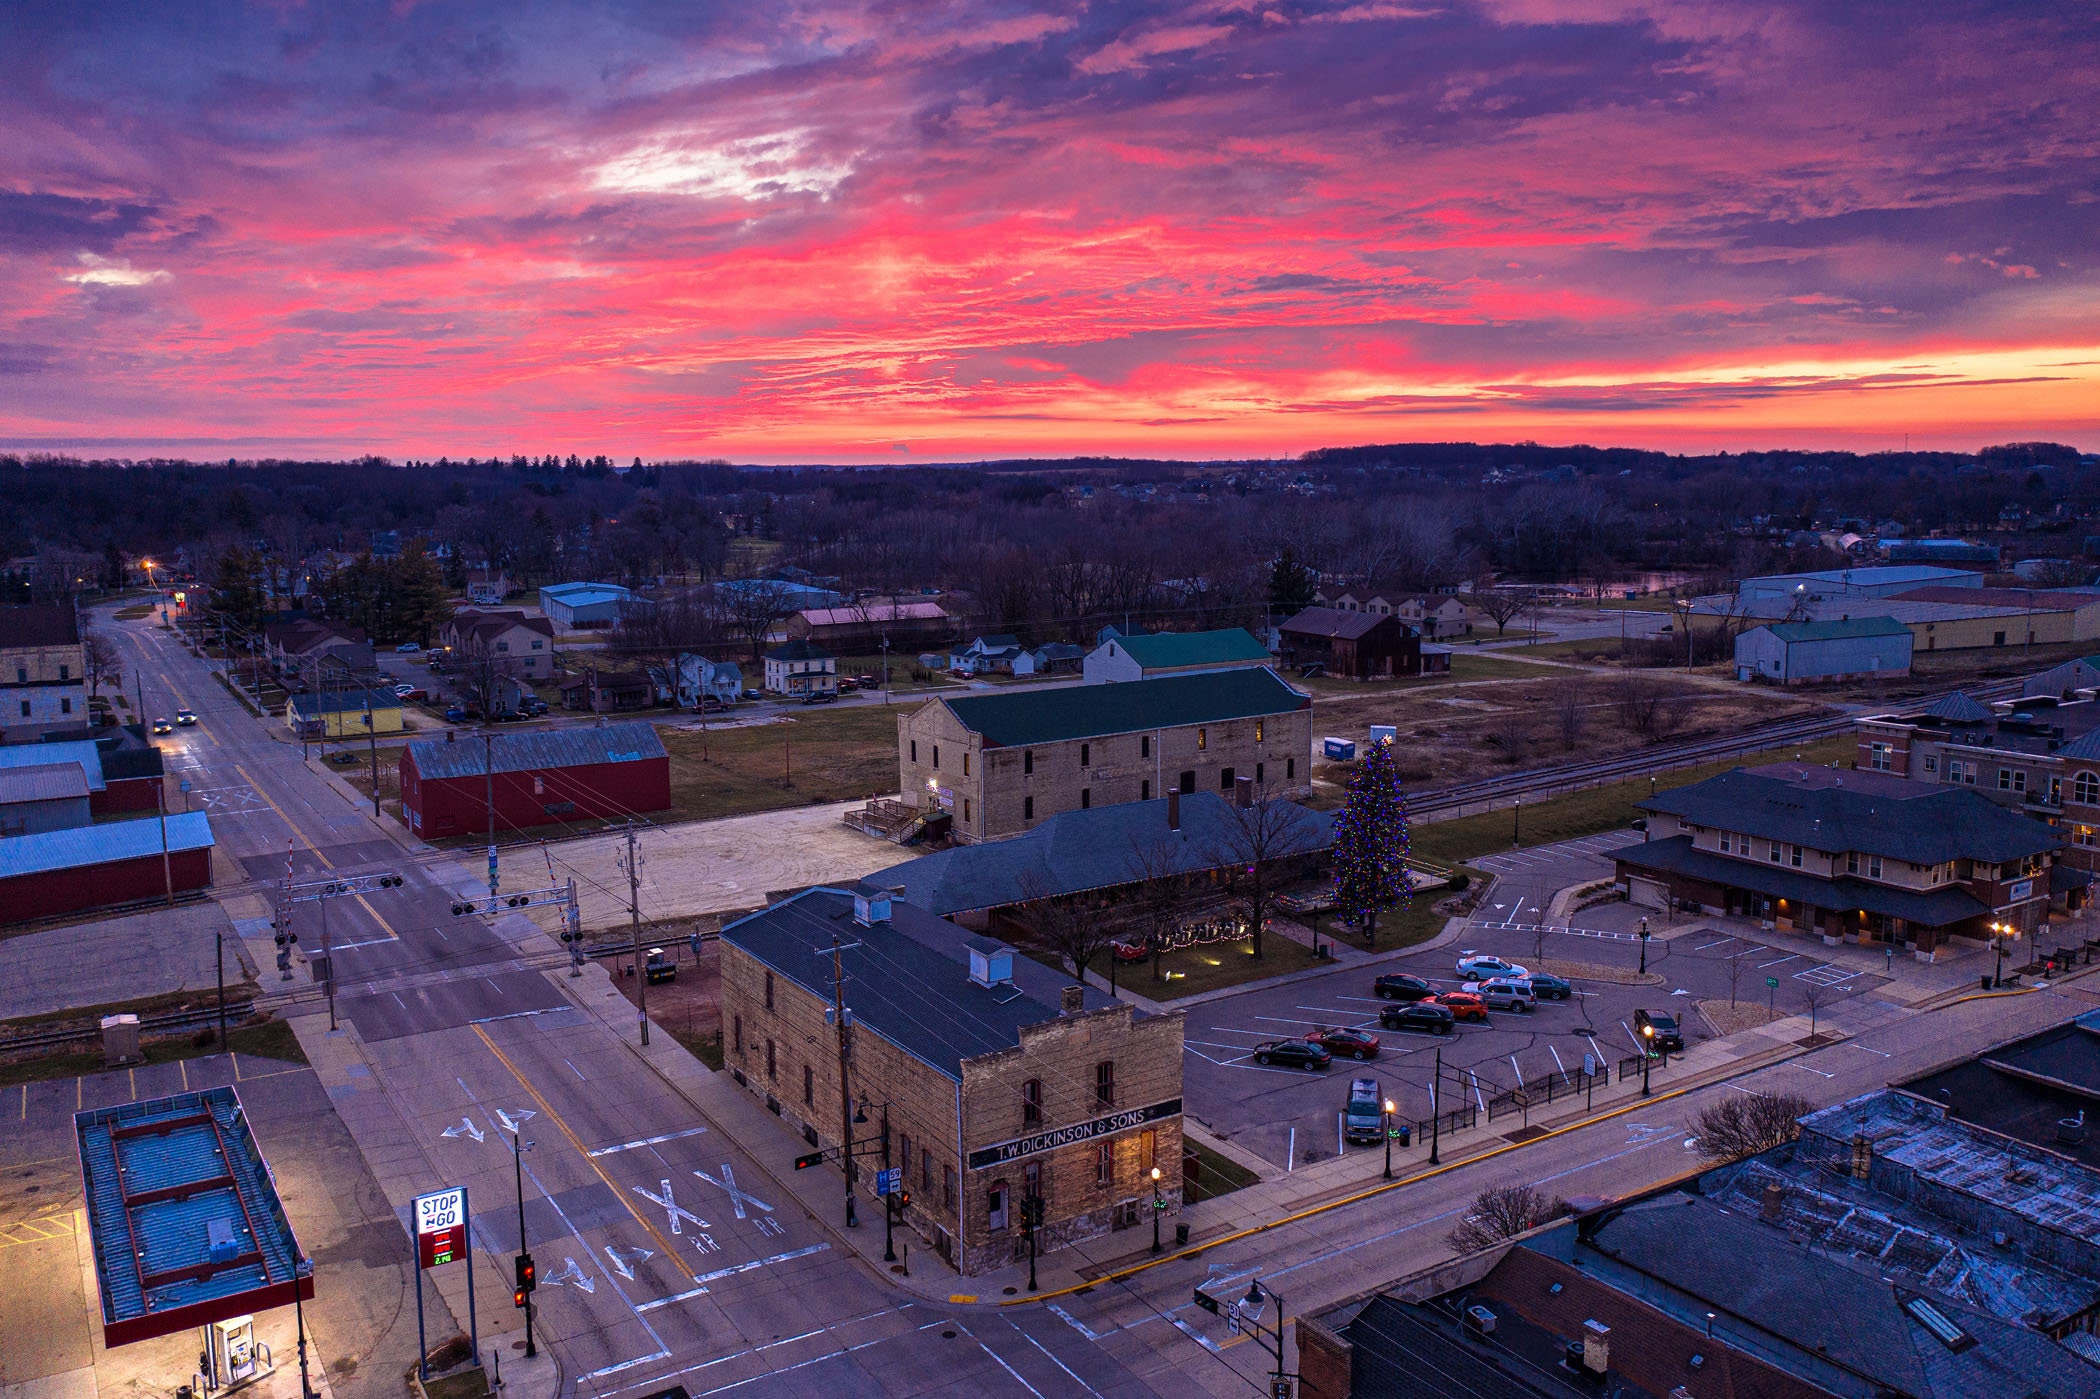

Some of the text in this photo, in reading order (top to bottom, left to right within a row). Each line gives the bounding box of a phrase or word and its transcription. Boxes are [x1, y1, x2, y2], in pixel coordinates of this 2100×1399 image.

[1023, 1124, 1093, 1154] DICKINSON
[1097, 1120, 1106, 1133] &
[1110, 1109, 1145, 1131] SONS
[879, 1171, 887, 1183] H
[890, 1169, 900, 1179] 59
[422, 1195, 458, 1215] STOP
[436, 1210, 456, 1226] GO
[1229, 1304, 1238, 1317] 51
